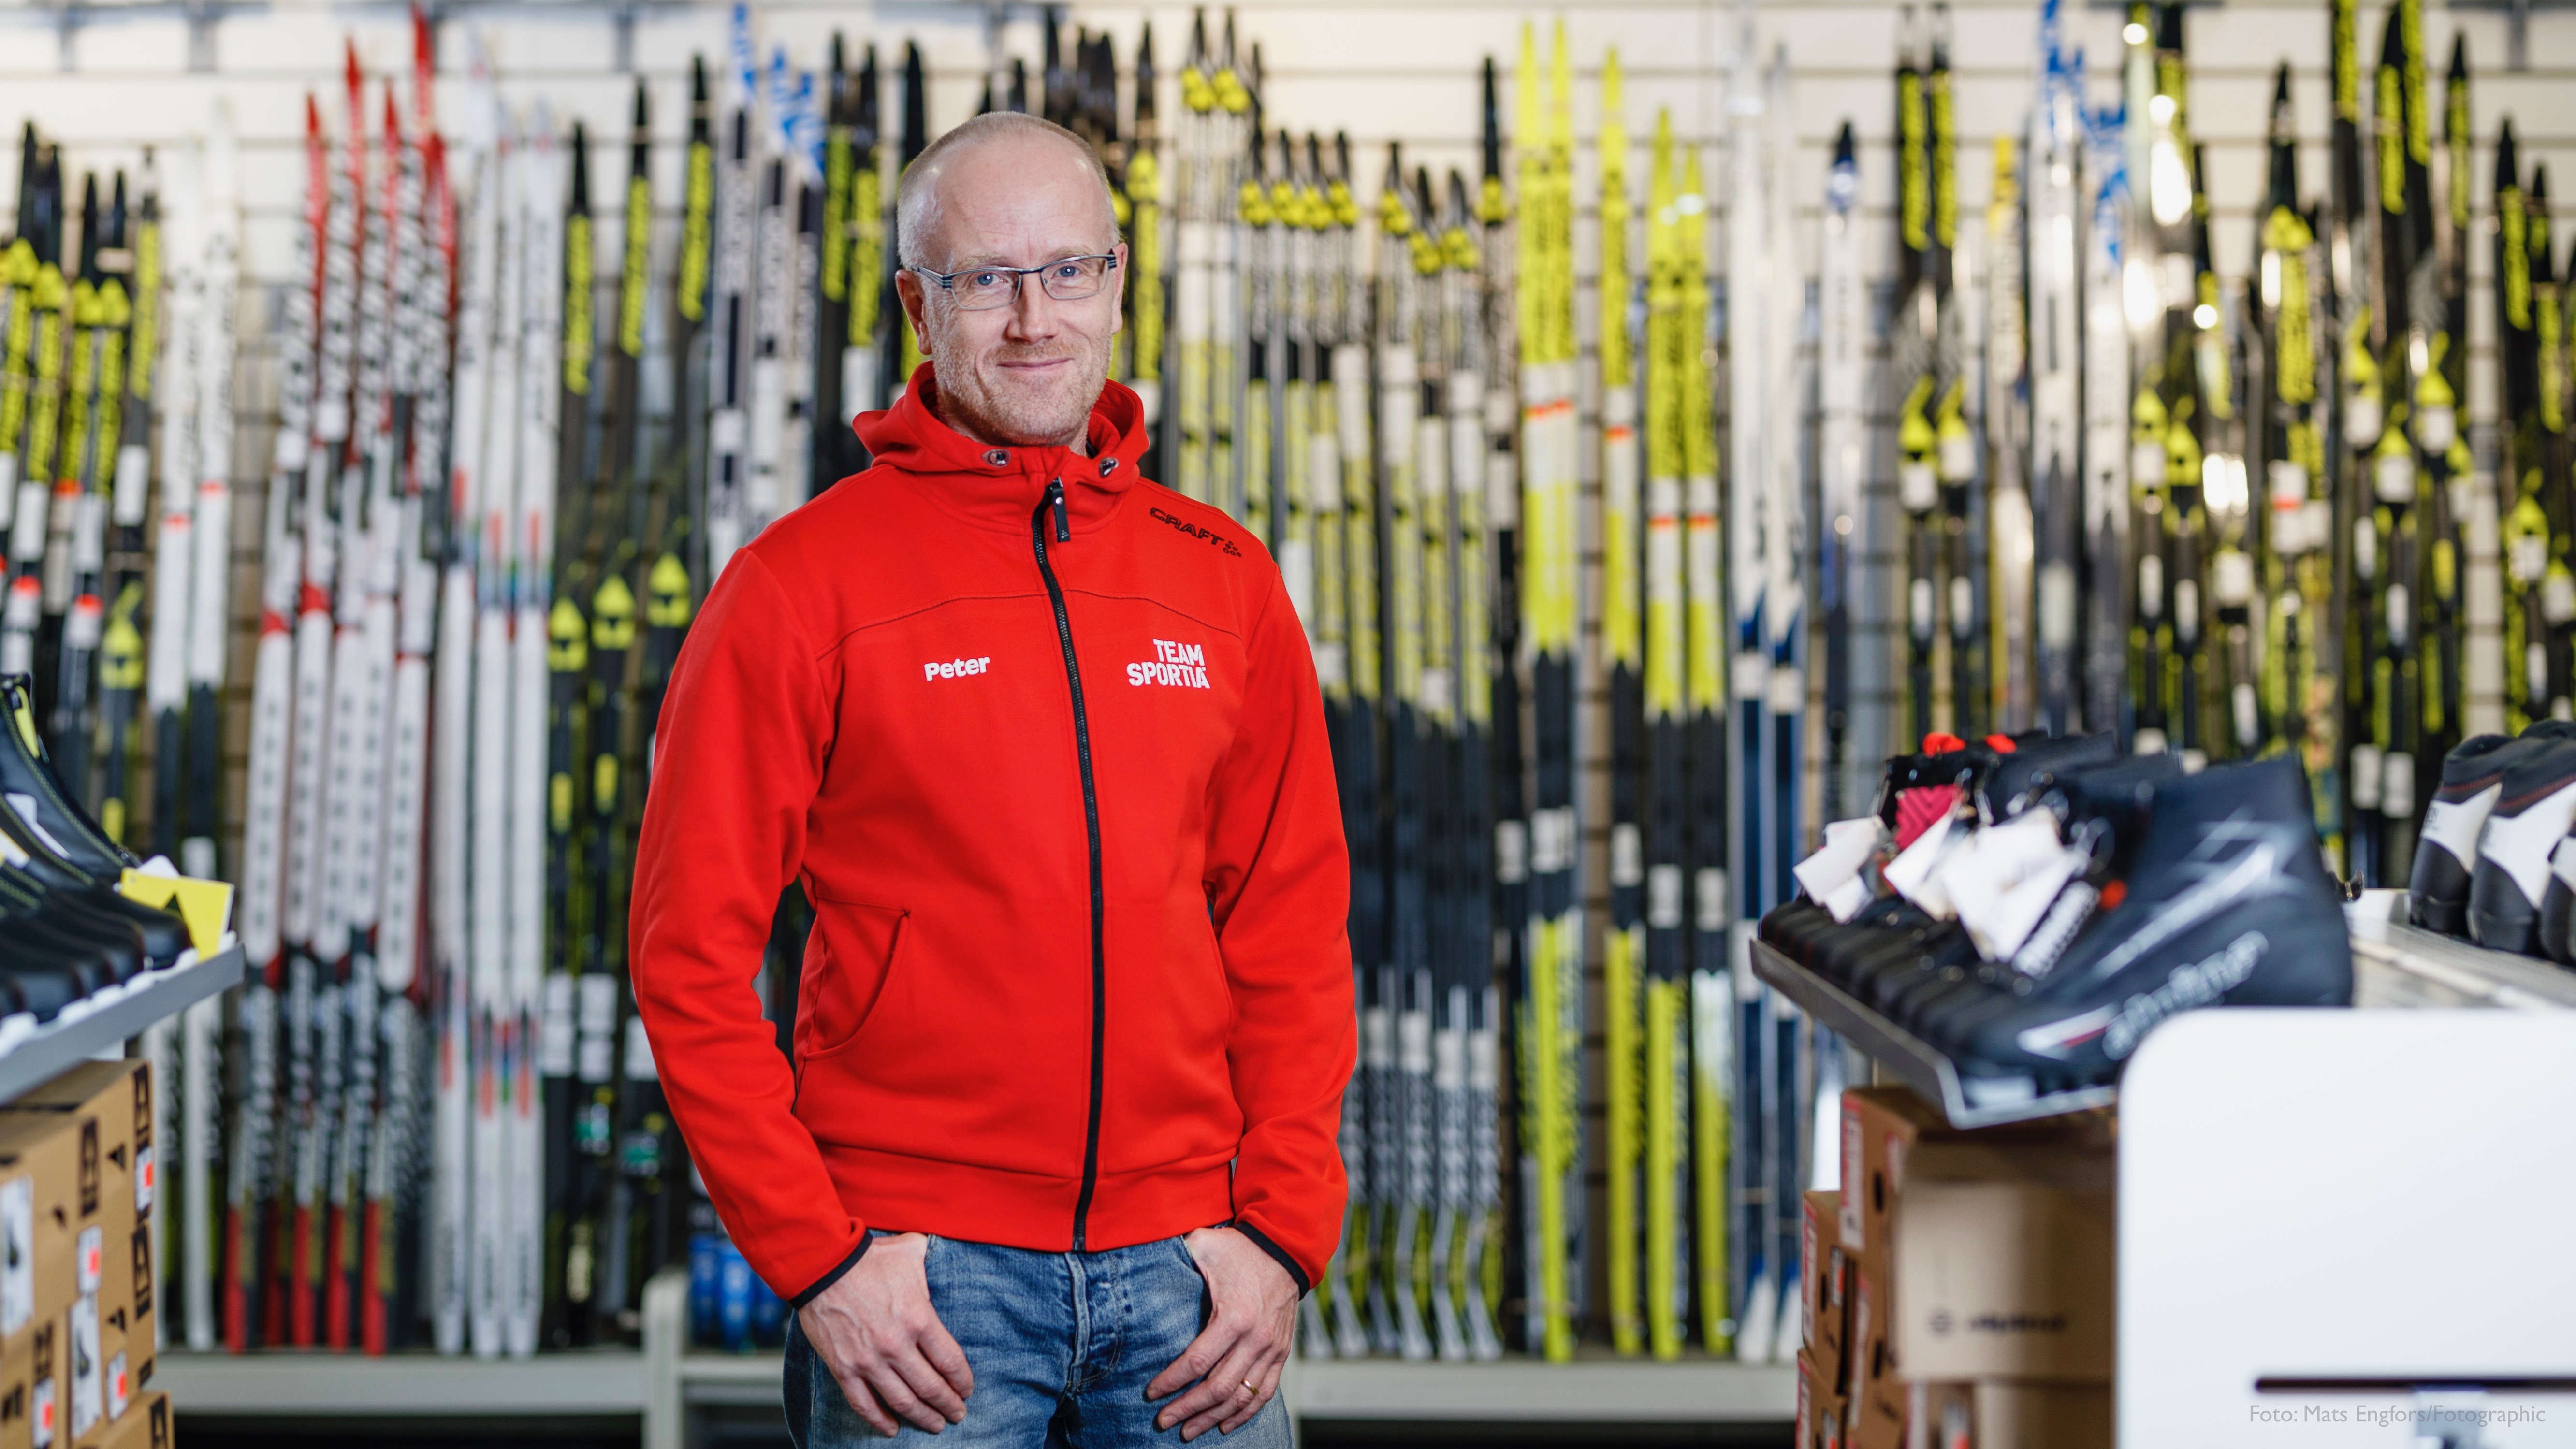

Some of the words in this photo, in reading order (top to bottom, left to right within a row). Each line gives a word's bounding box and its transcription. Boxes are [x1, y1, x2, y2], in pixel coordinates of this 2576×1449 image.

[1150, 507, 1224, 545] CRAFT
[1152, 638, 1205, 666] TEAM
[924, 656, 990, 681] Peter
[1126, 661, 1210, 689] SPORTIA
